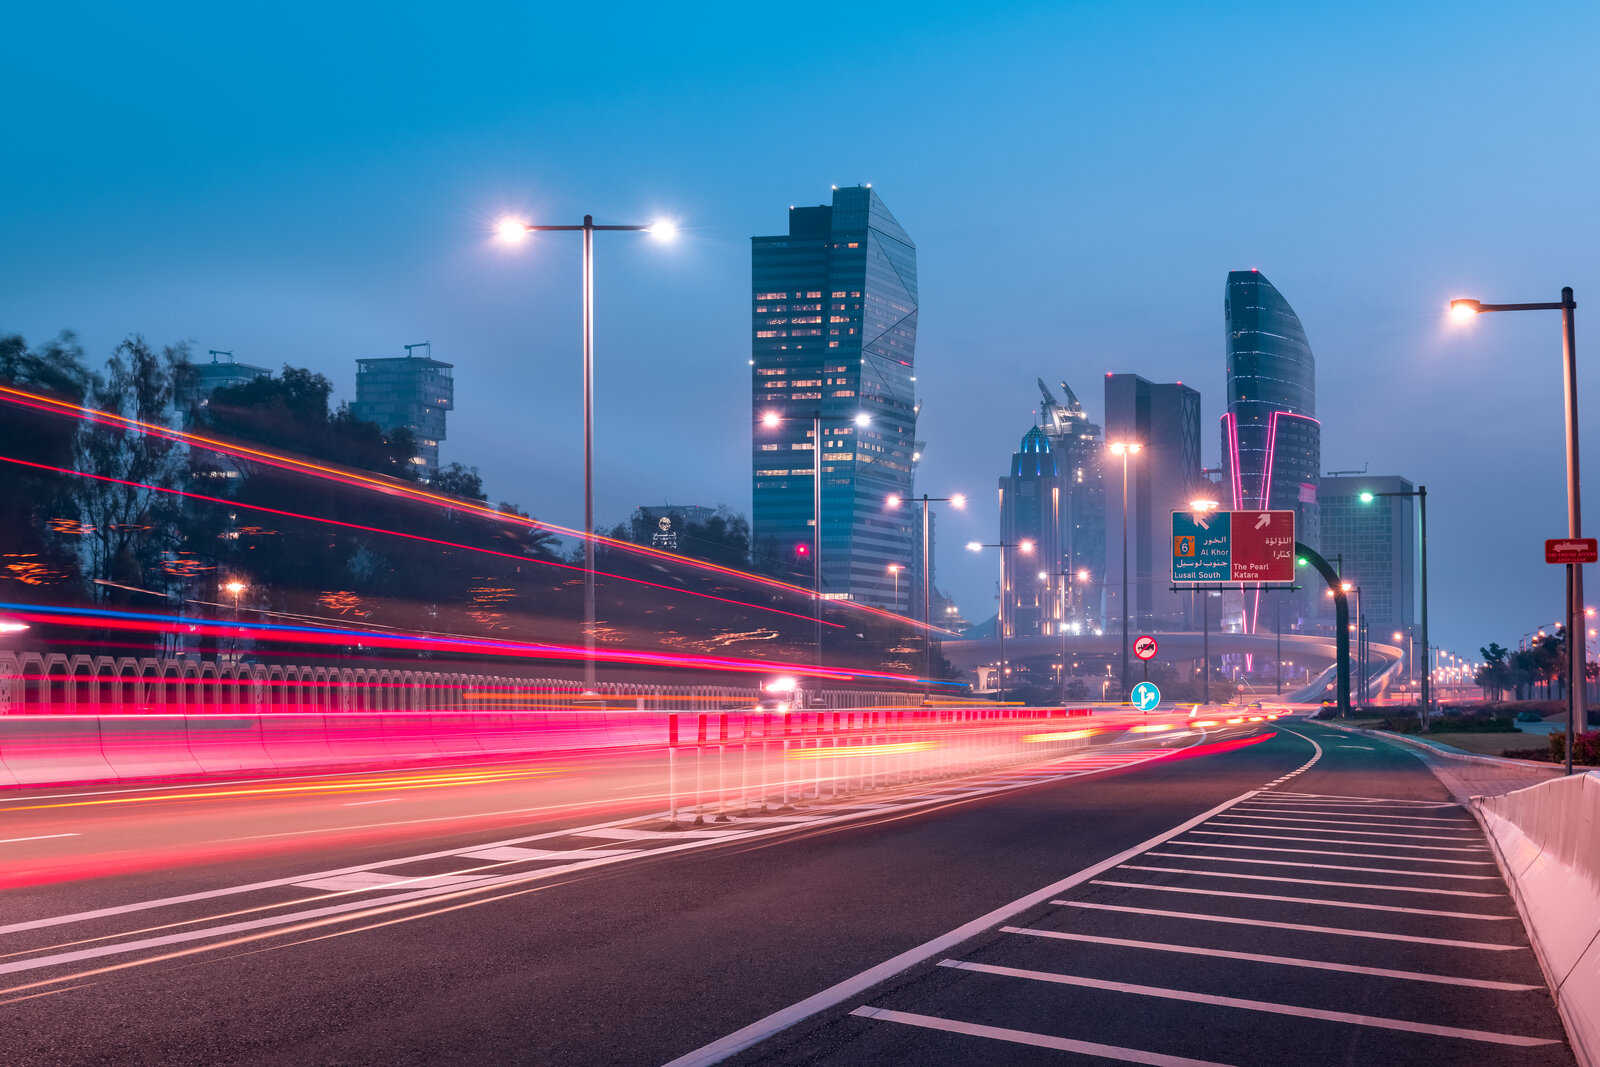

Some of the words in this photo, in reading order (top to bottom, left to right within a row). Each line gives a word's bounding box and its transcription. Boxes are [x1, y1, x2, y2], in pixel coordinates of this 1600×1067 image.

[1203, 536, 1227, 546] الخور
[1265, 536, 1292, 546] اللؤلؤة
[1181, 542, 1189, 553] 6
[1200, 548, 1209, 556] Al
[1211, 548, 1229, 556] Khor
[1273, 550, 1291, 560] كتارا
[1176, 559, 1202, 568] لوسيل
[1203, 559, 1228, 568] جنوب
[1174, 571, 1197, 579] Lusail
[1198, 571, 1221, 579] South
[1233, 571, 1259, 579] Katara
